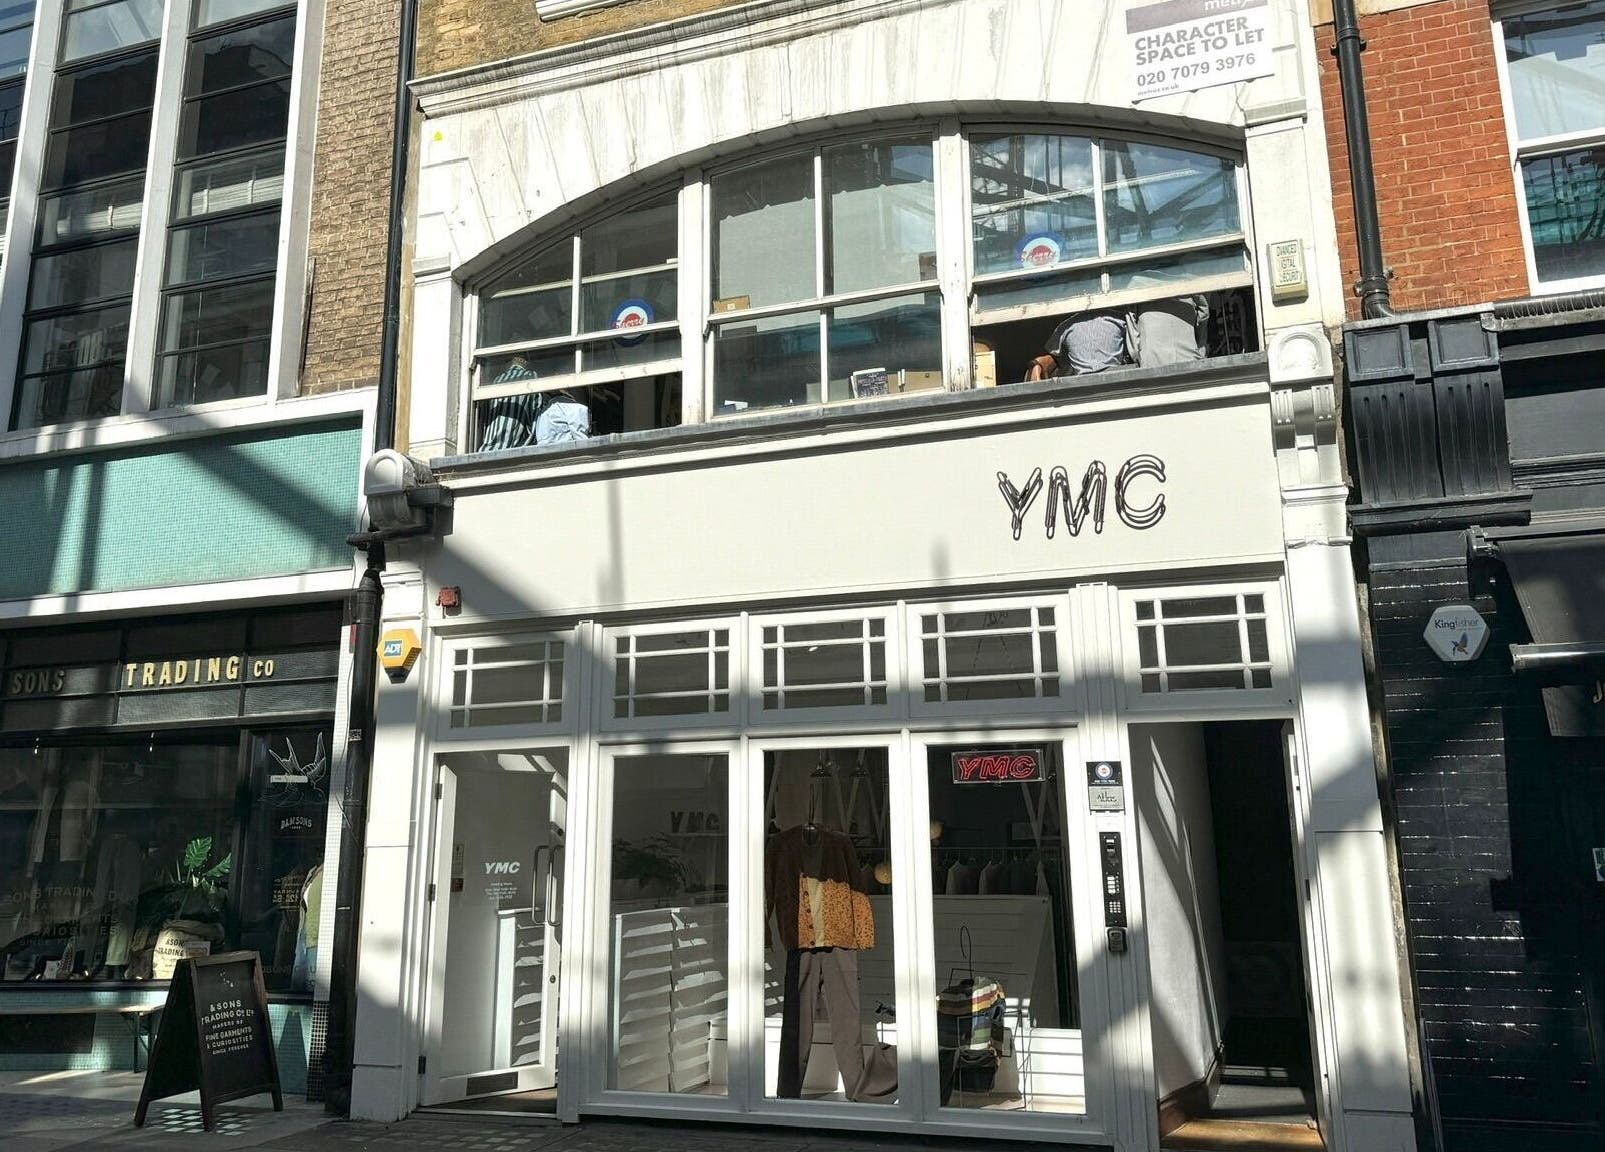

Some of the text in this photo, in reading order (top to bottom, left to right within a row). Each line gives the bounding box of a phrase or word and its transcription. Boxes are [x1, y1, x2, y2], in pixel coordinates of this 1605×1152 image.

[1135, 16, 1248, 51] CHARACTER
[1136, 28, 1264, 66] SPACE TO LET
[1137, 53, 1255, 87] 020 7079 3976
[997, 454, 1166, 541] YMC
[385, 642, 402, 655] ADT
[12, 655, 275, 695] SONS TRADING CO
[958, 755, 1035, 780] YMC
[485, 861, 520, 874] YMC
[201, 1010, 235, 1025] TRADING
[205, 1026, 252, 1041] FINE GARMENTS
[211, 1035, 253, 1048] CURIOSITIES
